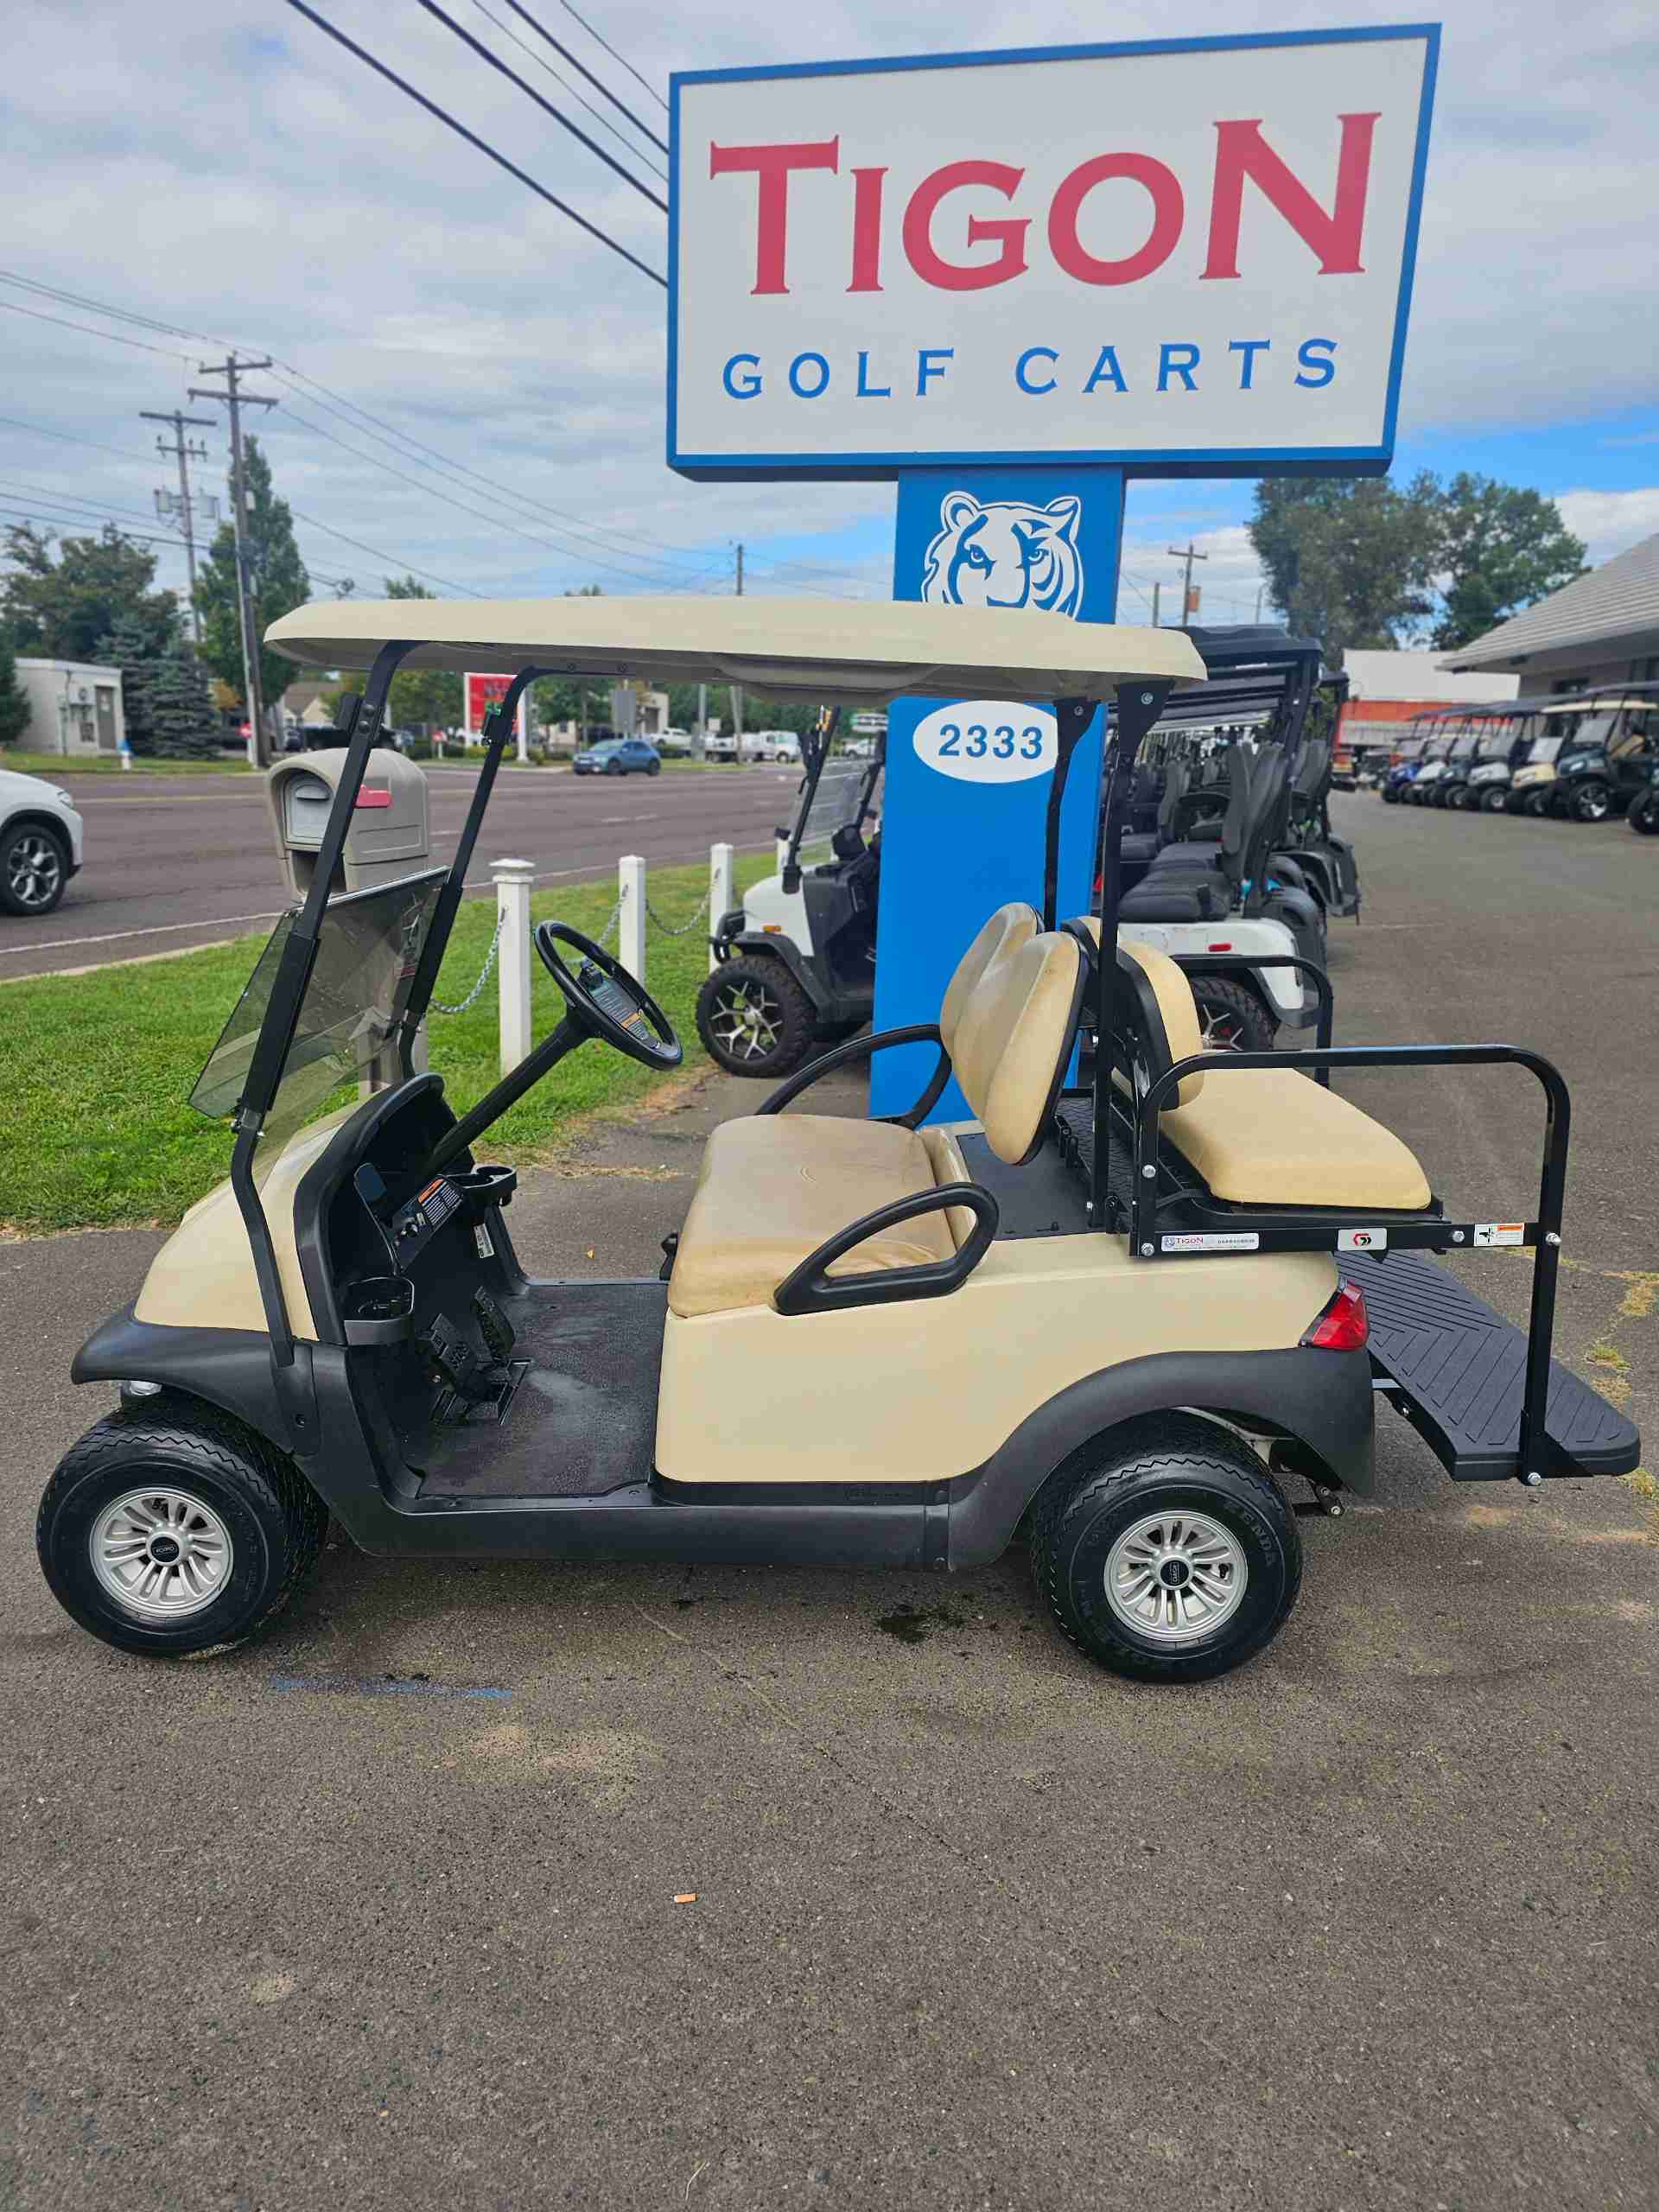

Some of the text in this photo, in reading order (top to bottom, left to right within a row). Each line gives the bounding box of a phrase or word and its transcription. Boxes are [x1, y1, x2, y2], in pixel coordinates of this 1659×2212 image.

[710, 112, 1382, 295] TIGON
[722, 338, 1338, 400] GOLF CARTS
[939, 723, 1043, 760] 2333
